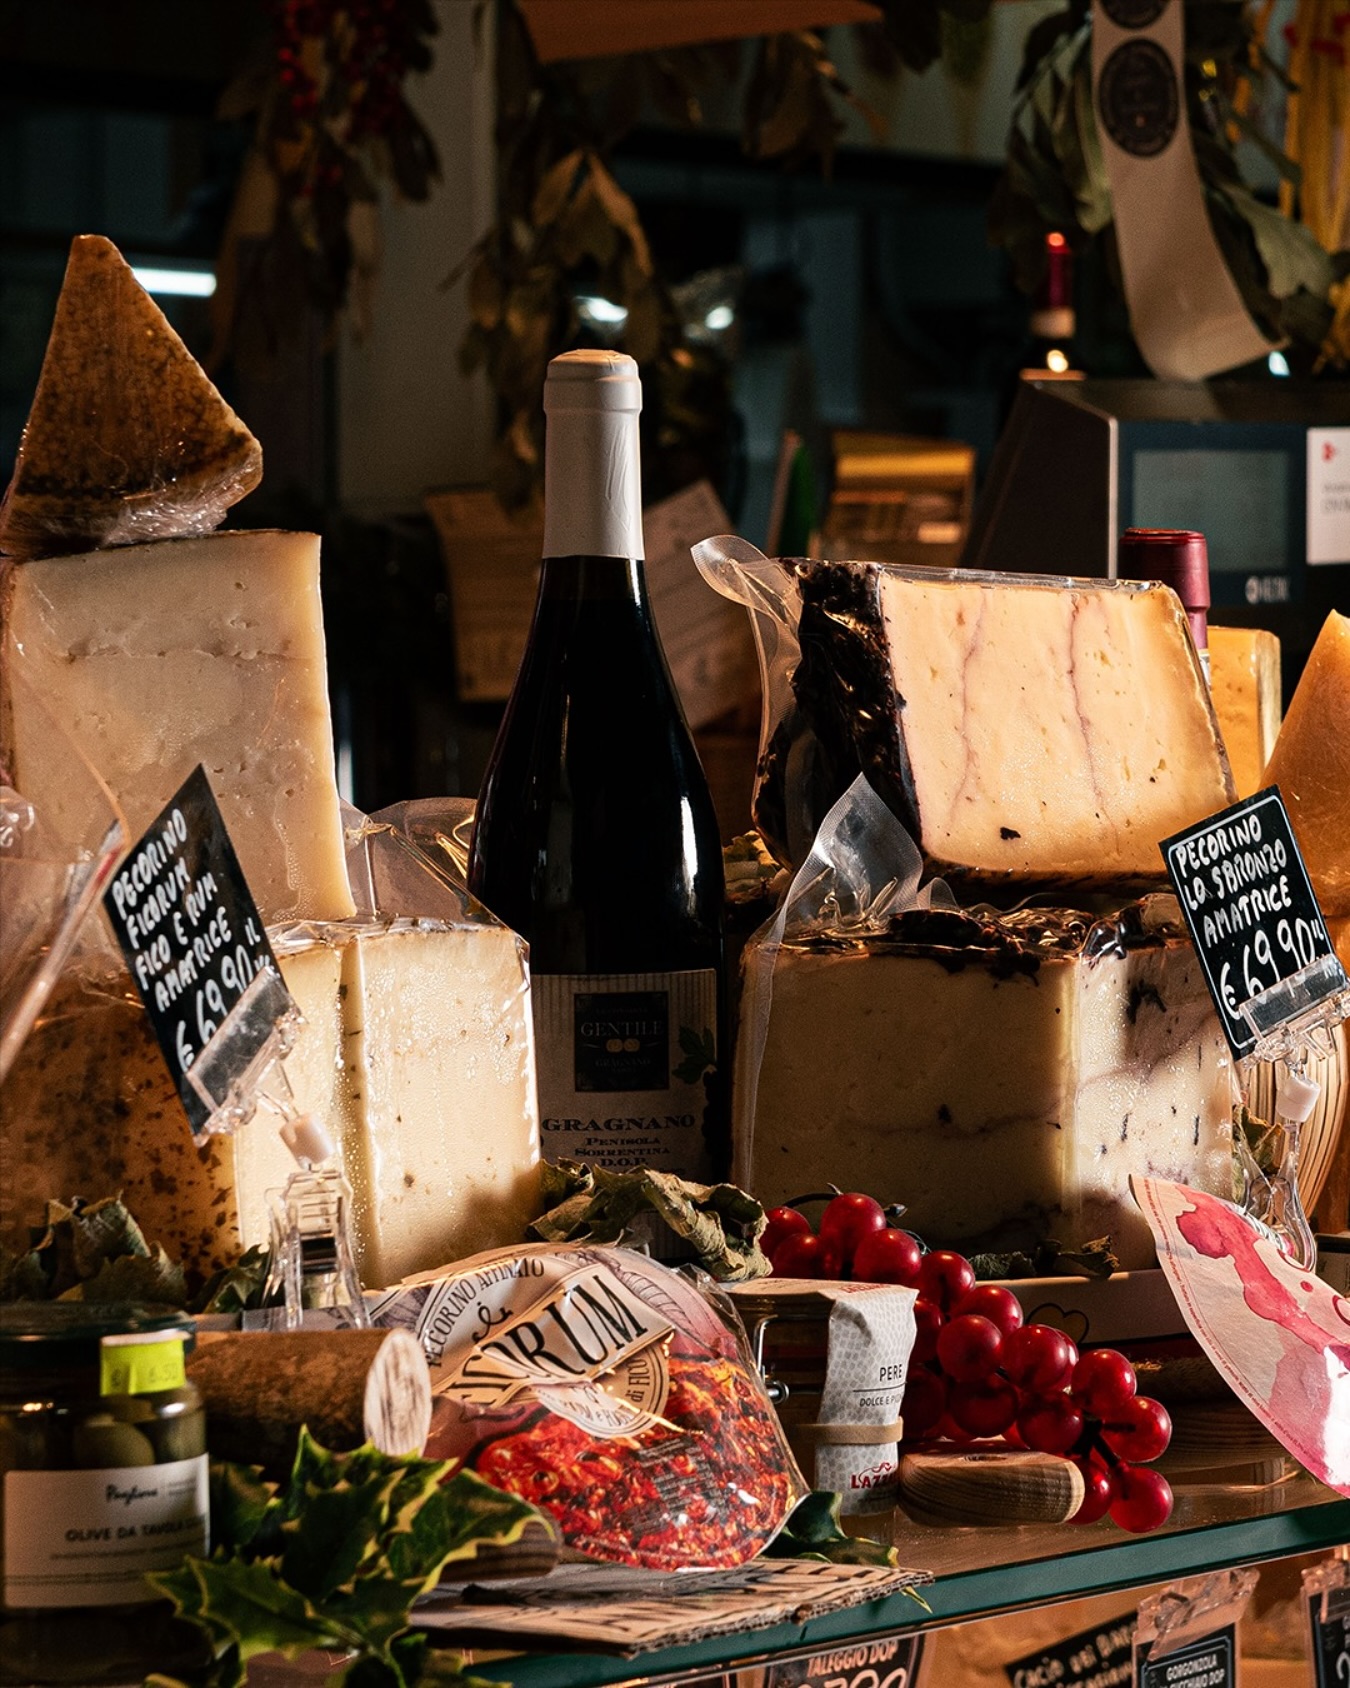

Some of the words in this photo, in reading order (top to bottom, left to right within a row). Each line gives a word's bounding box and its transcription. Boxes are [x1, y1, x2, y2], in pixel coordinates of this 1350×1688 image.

[112, 807, 188, 920] PECORINO
[1175, 813, 1262, 879] PECORINO
[1211, 838, 1288, 900] SBRONZO
[126, 857, 191, 950] FICORUM
[1203, 874, 1293, 949] AMATRICE
[135, 933, 171, 991] FICO
[173, 911, 188, 945] E
[186, 870, 219, 927] RUM
[154, 905, 232, 1013] AMATRICE
[580, 1020, 664, 1038] GENTILE
[542, 1114, 696, 1132] GRAGNANO
[879, 1363, 903, 1382] PERE
[859, 1396, 884, 1407] DOLCE
[64, 1527, 111, 1543] OLIVE
[116, 1525, 136, 1540] DA
[806, 1645, 868, 1678] TALEGGIO
[868, 1639, 899, 1665] DOP
[1165, 1654, 1218, 1681] GORGONZOLA
[1208, 1669, 1226, 1686] DOP
